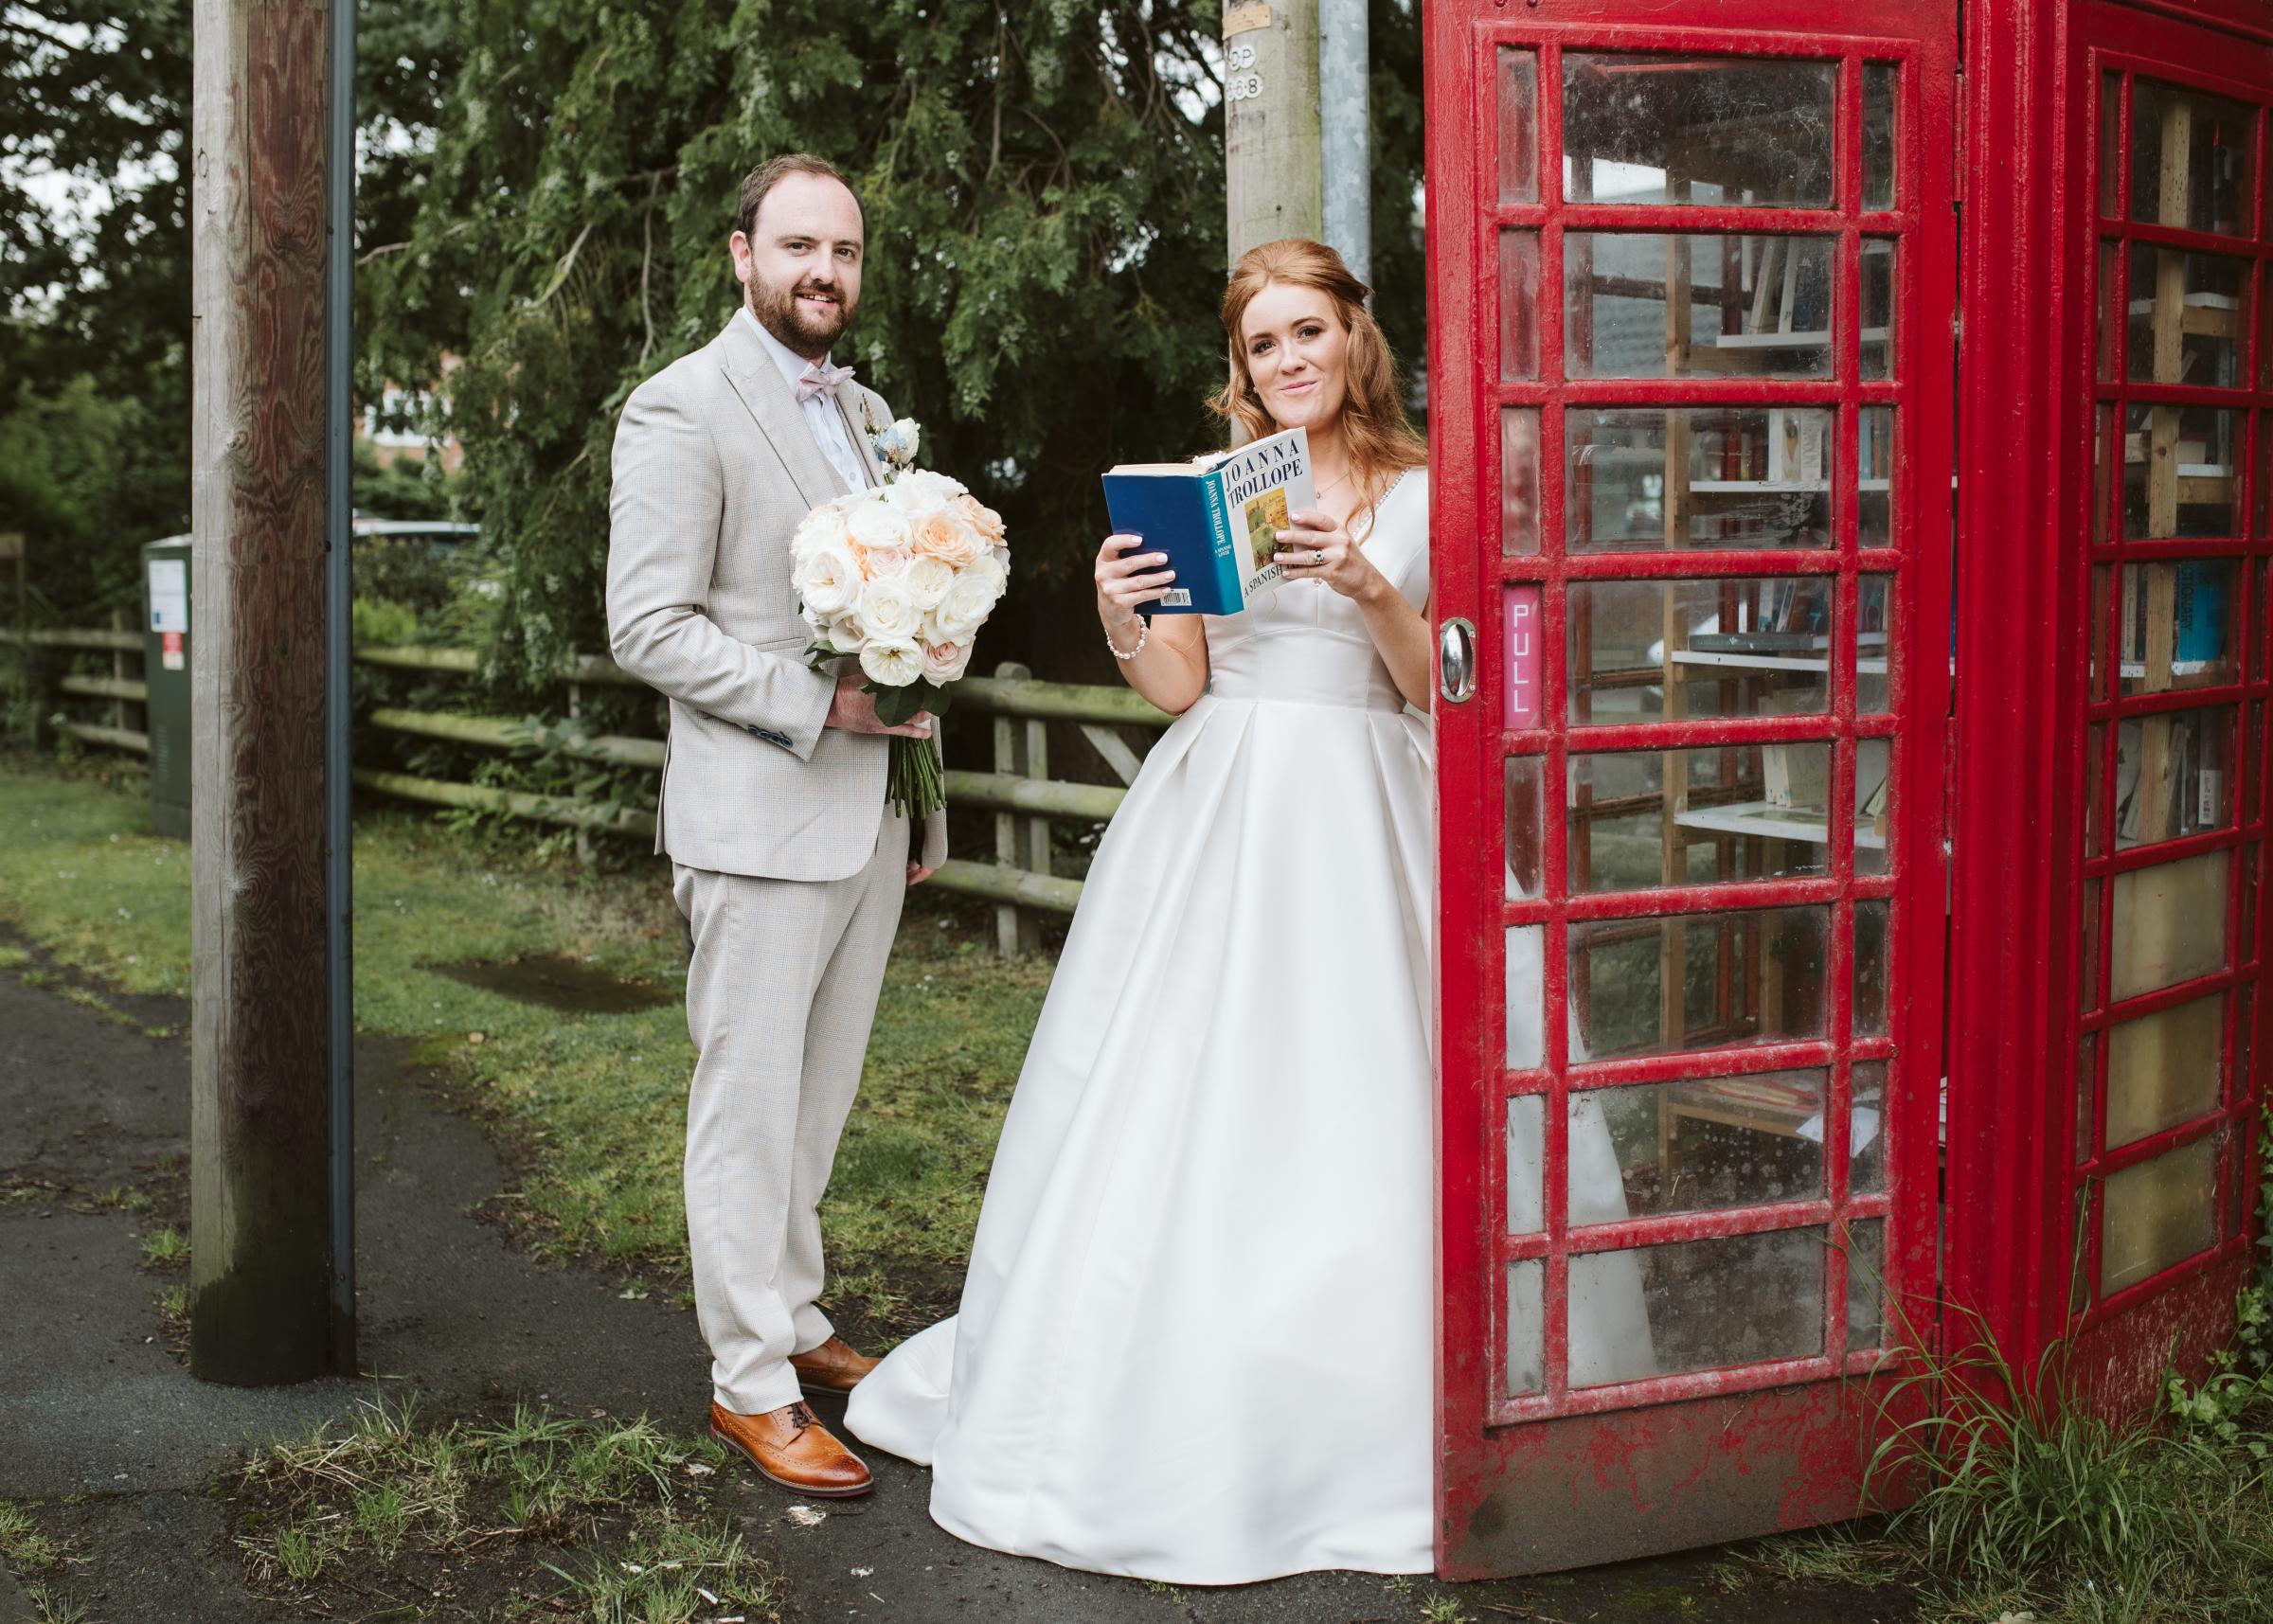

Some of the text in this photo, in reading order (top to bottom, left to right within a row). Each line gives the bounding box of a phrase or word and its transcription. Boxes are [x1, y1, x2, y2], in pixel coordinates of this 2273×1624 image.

[1226, 438, 1300, 492] JOANNA
[1227, 458, 1303, 509] TROLLOPE
[1206, 479, 1226, 545] JOANNA TROLLOPE
[1244, 563, 1284, 598] A SPANISH
[2180, 565, 2193, 632] CTIONARY
[1513, 604, 1530, 713] PULL
